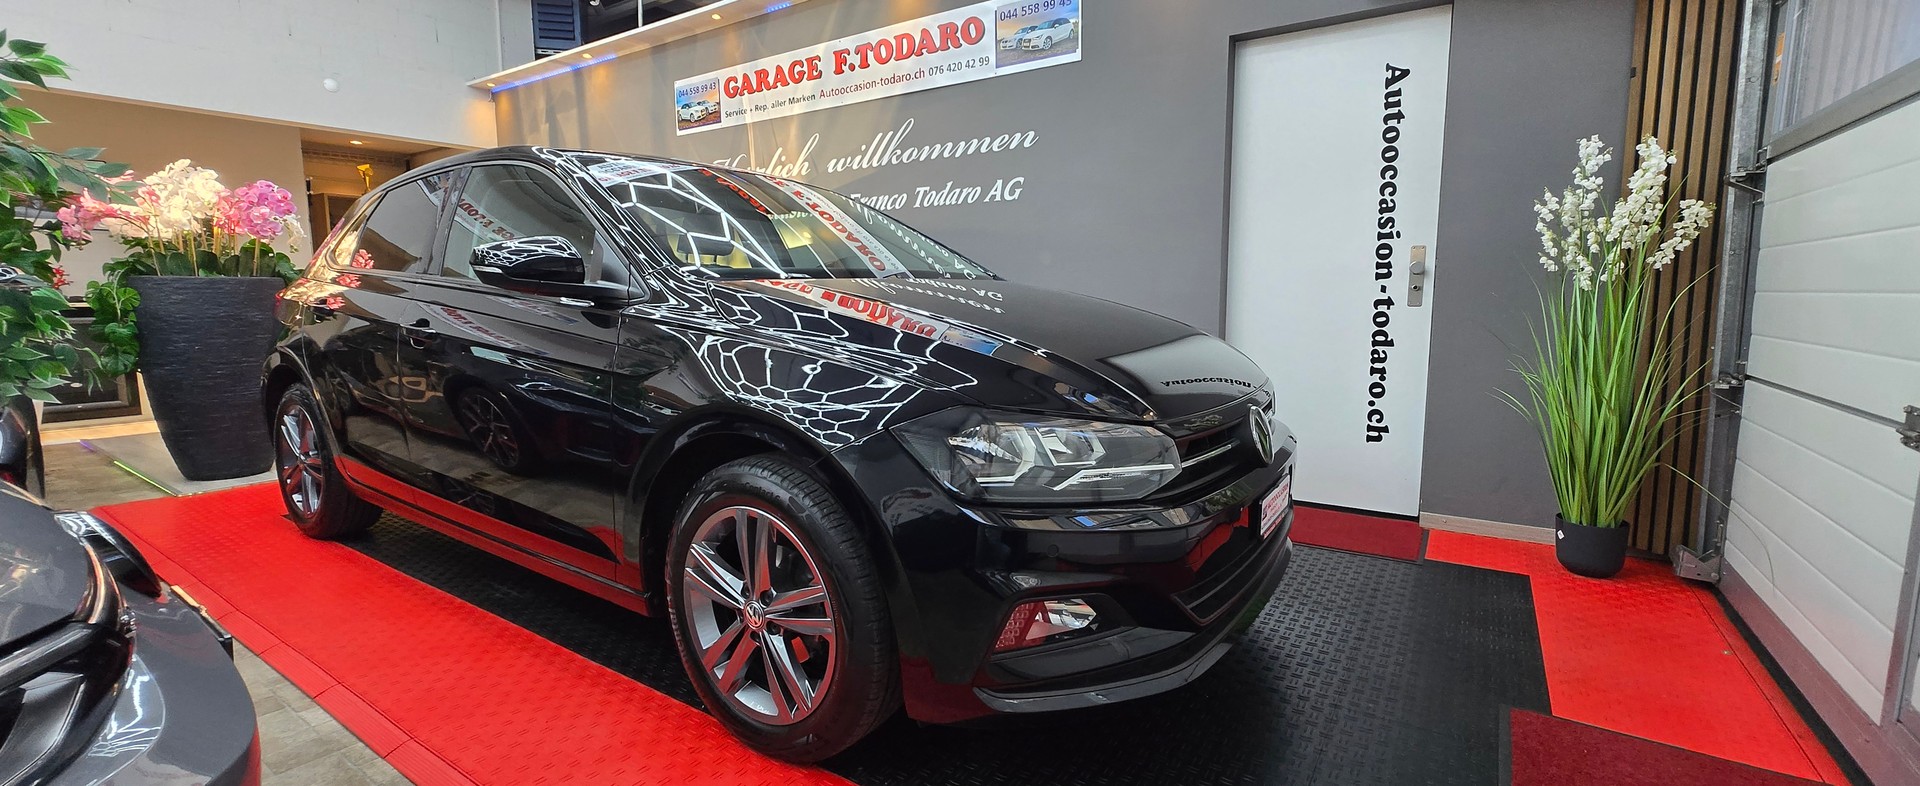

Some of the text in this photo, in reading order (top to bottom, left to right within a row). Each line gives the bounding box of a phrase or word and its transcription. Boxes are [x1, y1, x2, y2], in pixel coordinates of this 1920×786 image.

[999, 8, 1018, 21] 044
[1021, 3, 1040, 17] 558
[1043, 0, 1056, 11] 99
[723, 16, 986, 98] GARAGE F.TODARO
[724, 107, 748, 119] Service
[754, 104, 770, 113] Rep.
[770, 99, 787, 109] aller
[788, 93, 816, 106] Marken
[819, 67, 926, 100] Autooccasion-todaro.ch
[928, 64, 945, 77] 076
[946, 61, 963, 73] 420
[965, 58, 977, 70] 42
[979, 55, 990, 67] 99
[678, 81, 717, 98] 044 558 99 43
[712, 117, 1040, 178] lich willkommen
[913, 181, 982, 209] Todaro
[984, 176, 1025, 203] AG
[1365, 61, 1412, 445] Autooccasion-todaro.ch
